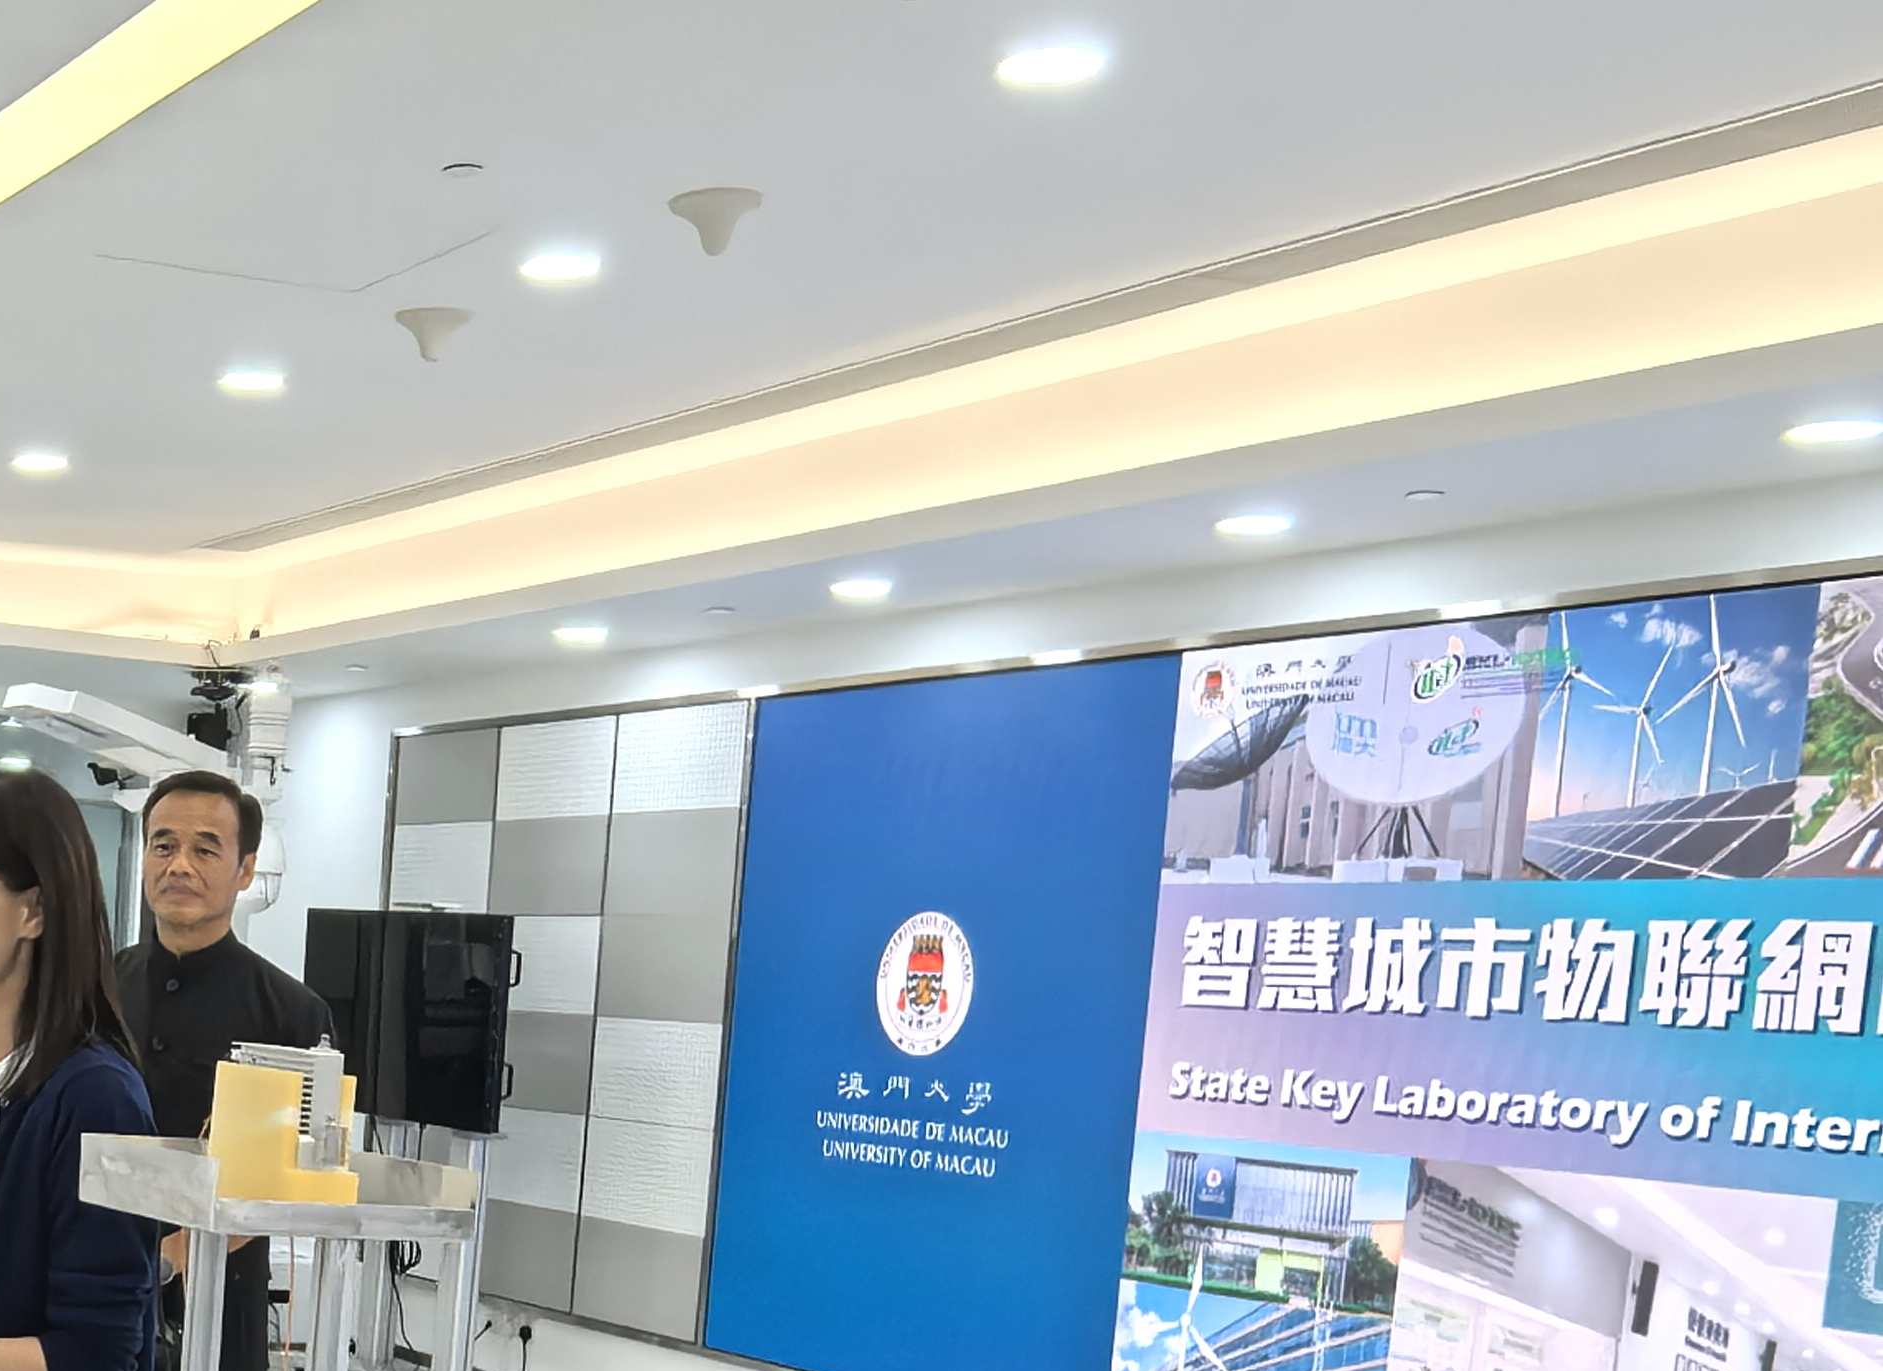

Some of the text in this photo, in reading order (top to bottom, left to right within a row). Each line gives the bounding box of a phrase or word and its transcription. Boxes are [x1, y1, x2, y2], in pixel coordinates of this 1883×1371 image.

[1181, 915, 1883, 1035] 智慧城市物聯網
[837, 1072, 992, 1115] 澳門大學
[1168, 1060, 1883, 1154] State Key Laboratory of Inter
[817, 1110, 1009, 1149] UNIVERSIDADE DE MACAU
[823, 1139, 996, 1177] UNIVERSITY OF MACAU
